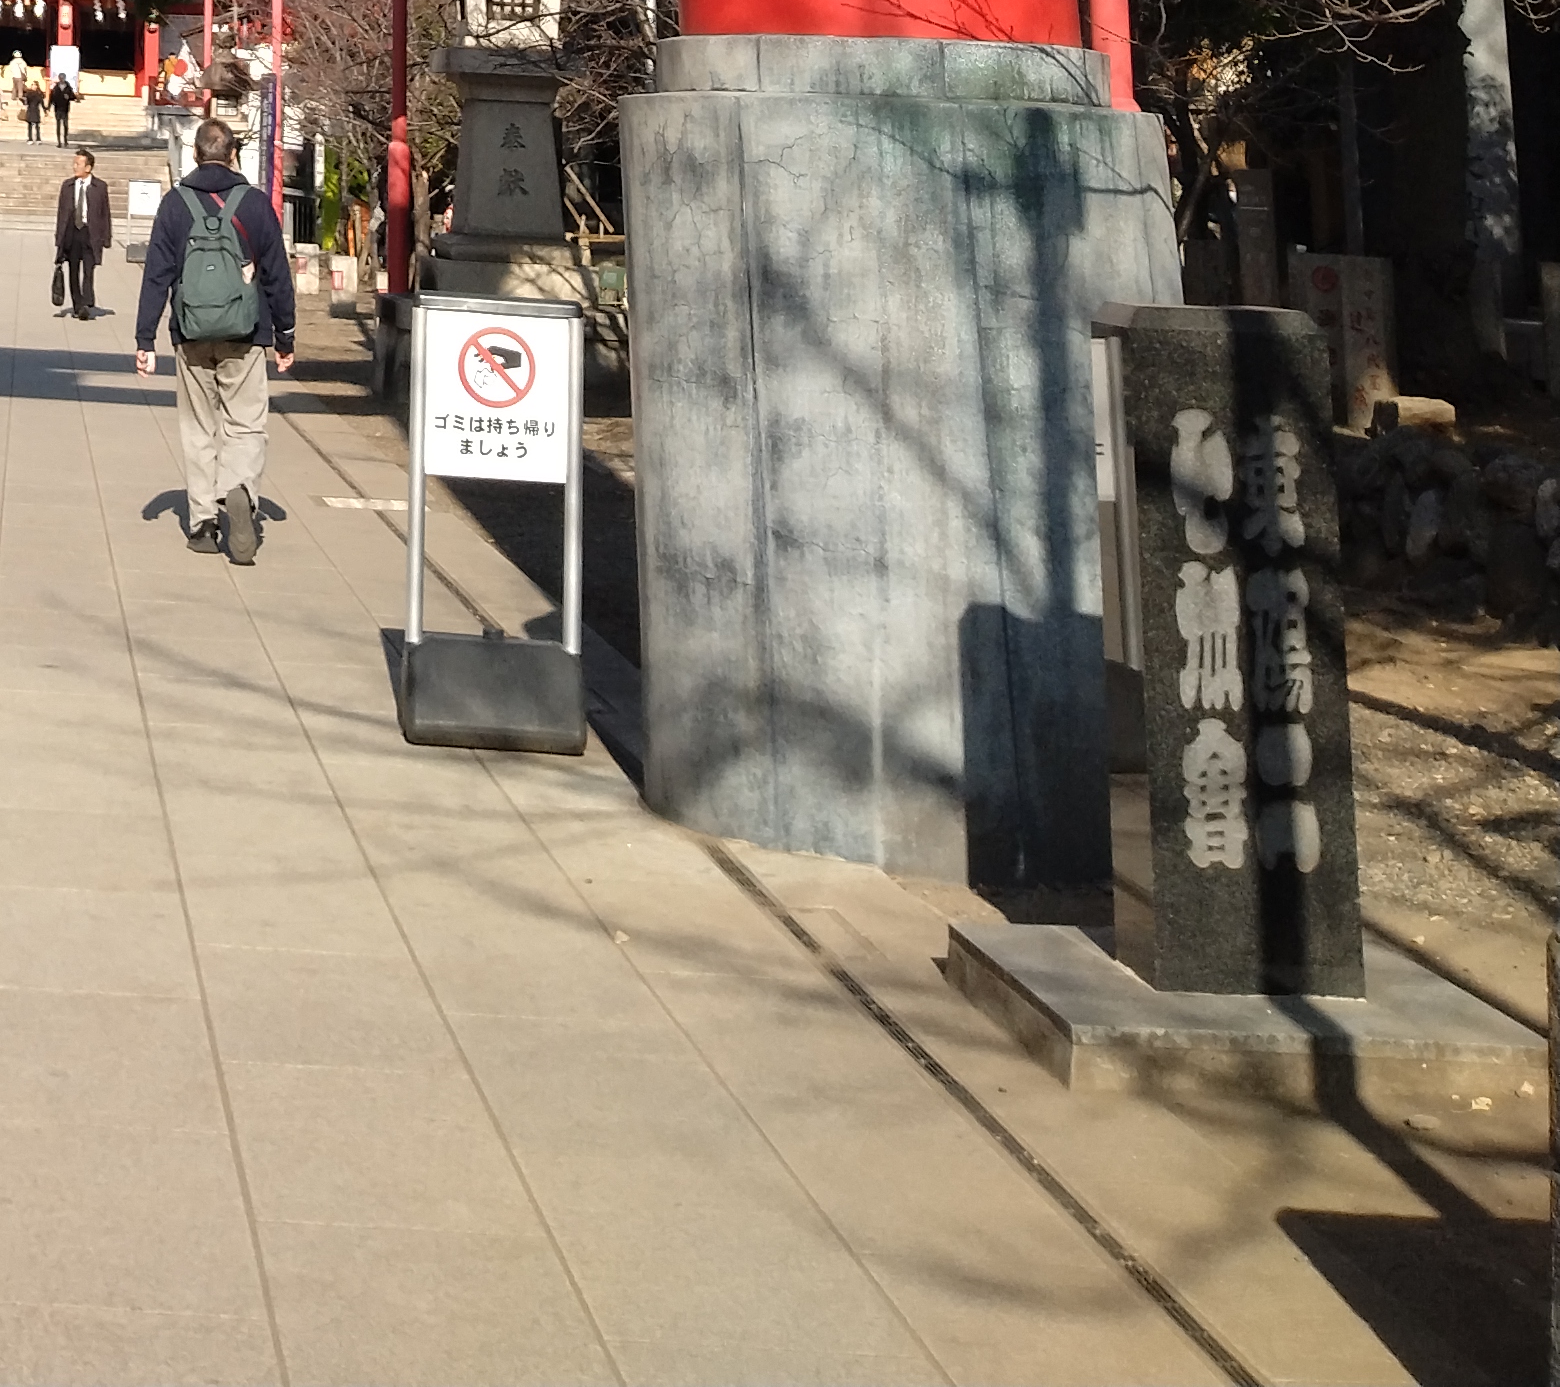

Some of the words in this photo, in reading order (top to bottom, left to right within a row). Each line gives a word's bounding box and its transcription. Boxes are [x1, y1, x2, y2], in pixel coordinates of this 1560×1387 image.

[433, 413, 557, 438] ゴミは持ち帰り
[459, 438, 529, 459] ましょう
